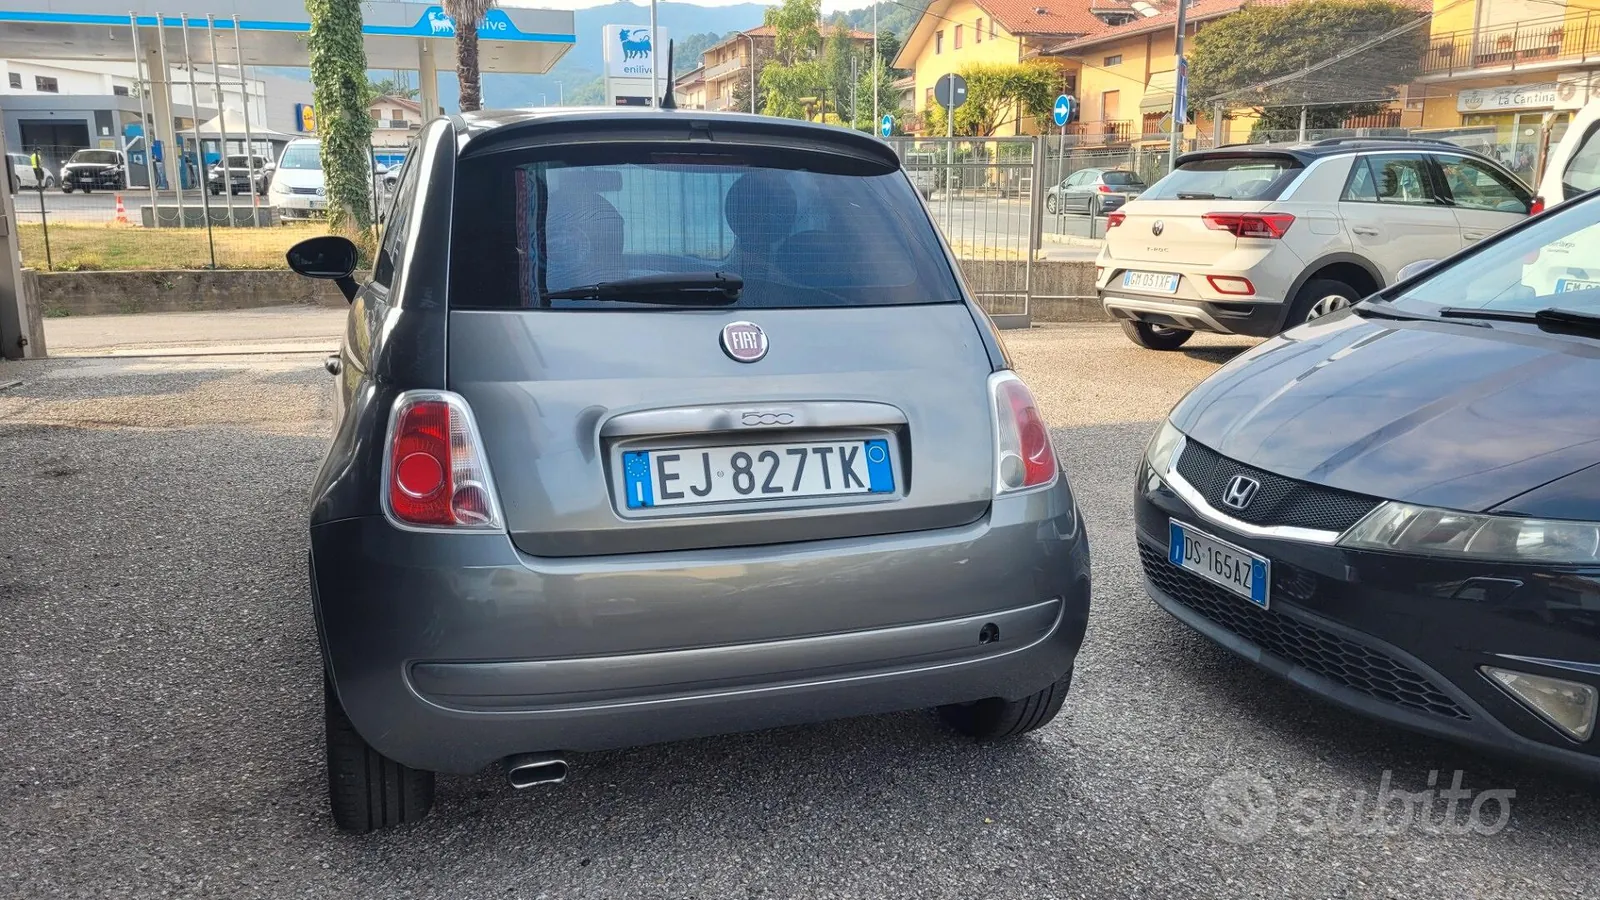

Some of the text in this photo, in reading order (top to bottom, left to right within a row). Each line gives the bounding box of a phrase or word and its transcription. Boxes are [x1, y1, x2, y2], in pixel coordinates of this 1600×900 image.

[1498, 92, 1555, 105] La Cantina
[731, 331, 758, 349] FIAT
[741, 411, 794, 426] 500
[656, 452, 713, 500] EJ
[730, 445, 865, 495] 827TK
[1185, 535, 1201, 564] DS
[1207, 546, 1252, 590] 165AZ
